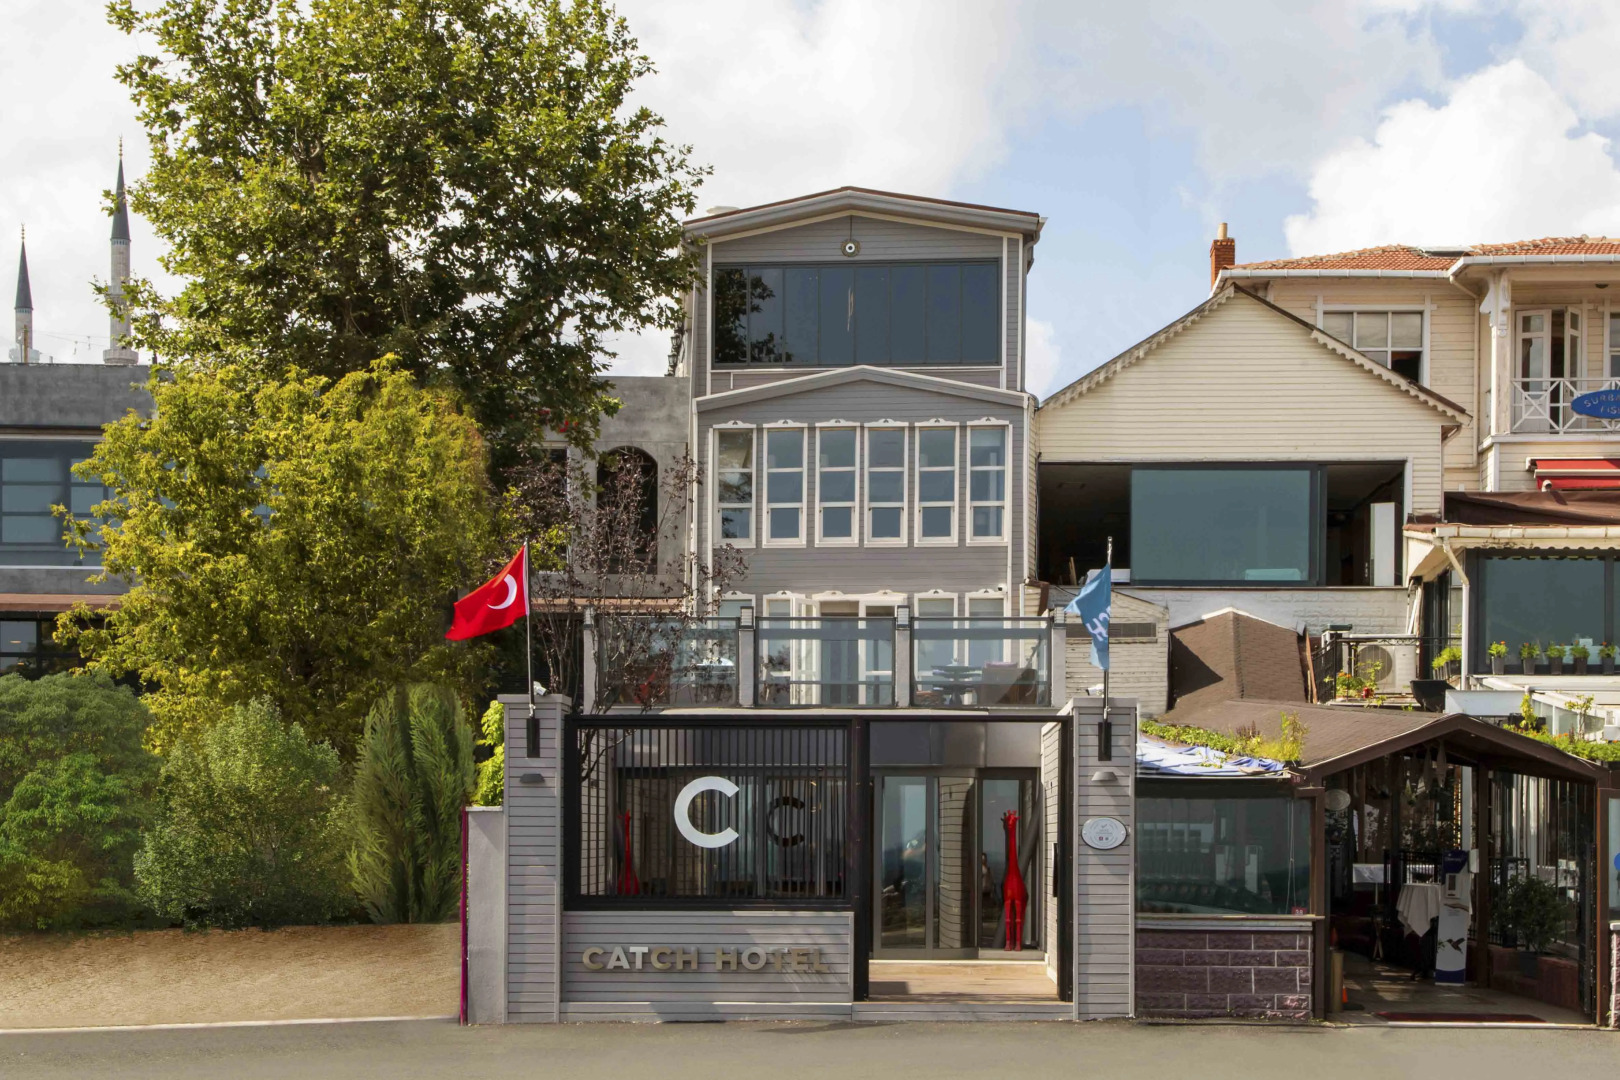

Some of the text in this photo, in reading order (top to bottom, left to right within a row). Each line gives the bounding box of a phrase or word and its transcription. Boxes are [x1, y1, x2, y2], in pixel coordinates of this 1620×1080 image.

[673, 775, 740, 849] C
[582, 946, 829, 971] CATCH HOTEL
